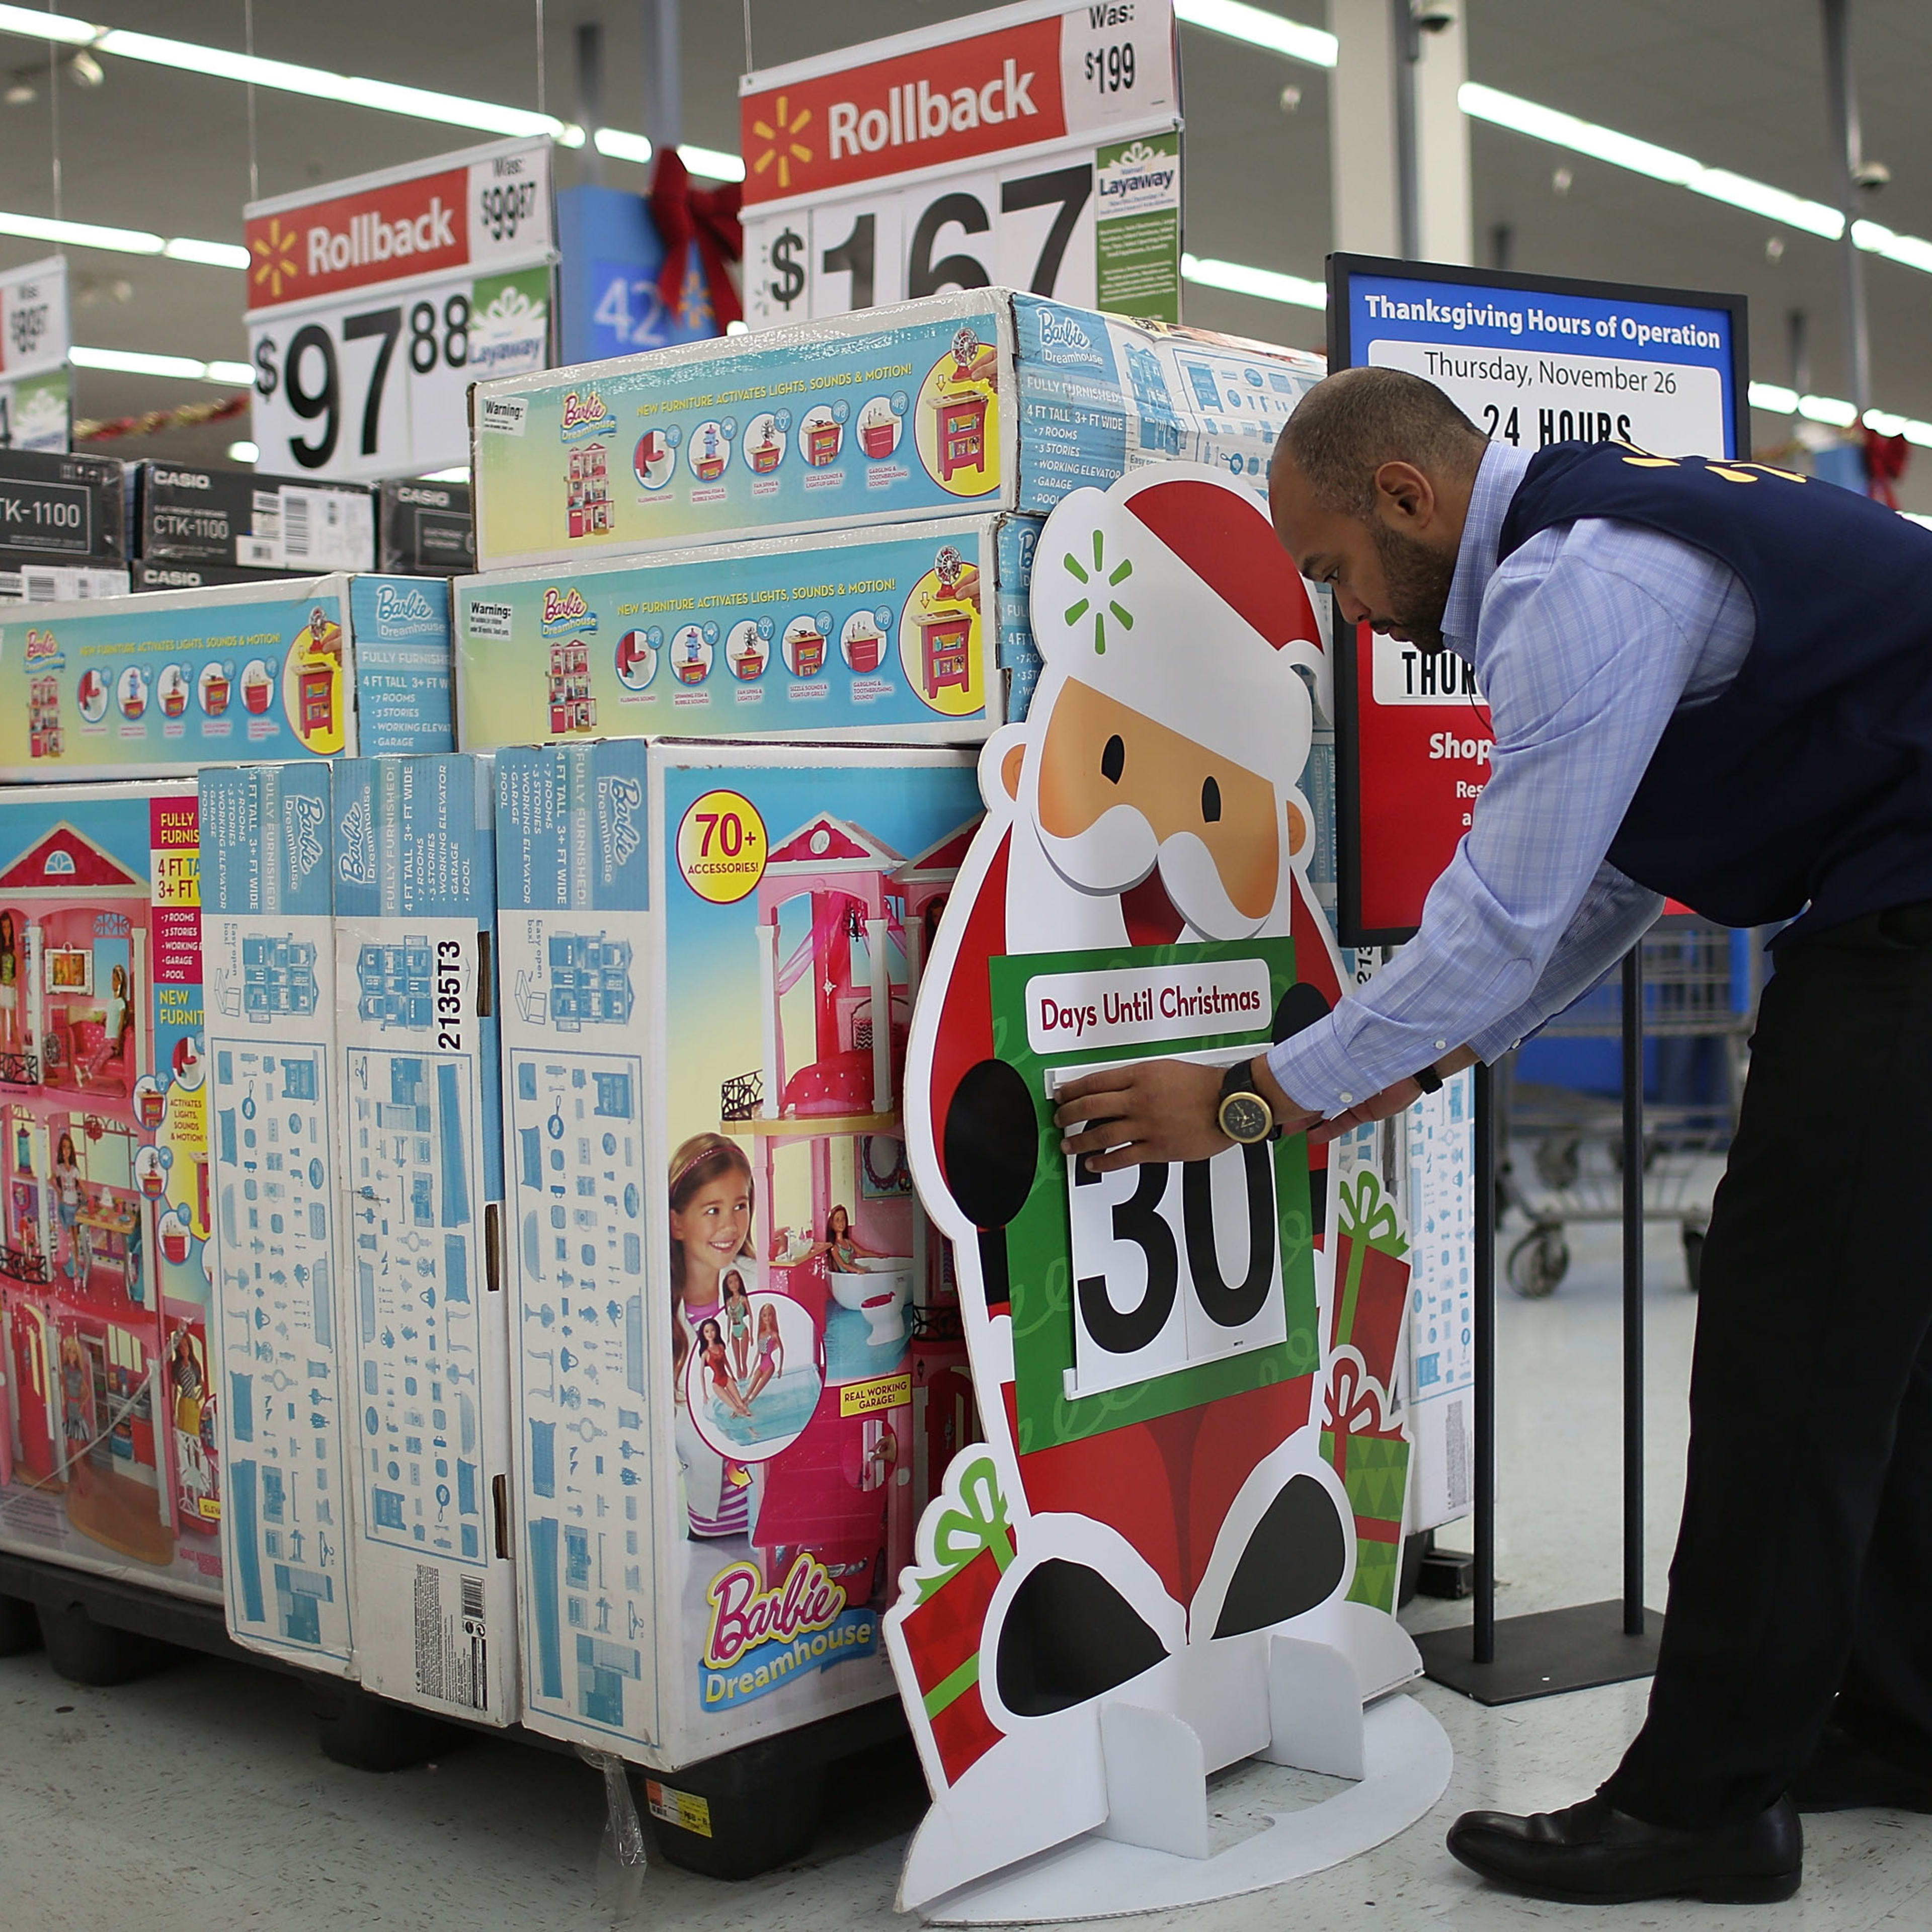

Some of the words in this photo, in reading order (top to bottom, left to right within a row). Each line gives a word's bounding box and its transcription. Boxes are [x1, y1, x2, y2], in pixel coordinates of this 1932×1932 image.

[1090, 4, 1134, 29] Was:
[1085, 42, 1135, 94] $199
[829, 59, 1038, 160] Rollback
[1100, 170, 1174, 197] Layaway
[307, 197, 455, 276] Rollback
[594, 277, 666, 345] 42
[1365, 295, 1522, 334] Thanksgiving
[1528, 308, 1591, 336] Hours
[1595, 315, 1617, 338] of
[1622, 317, 1720, 349] Operation
[1038, 309, 1089, 348] Barbie
[469, 337, 540, 365] Layaway
[1044, 349, 1103, 366] Dreamhouse
[1424, 351, 1532, 387] Thursday,
[1540, 361, 1647, 391] November
[1654, 371, 1676, 394] 26
[636, 403, 659, 417] NEW
[661, 395, 712, 413] FURNITURE
[716, 387, 766, 404] ACTIVATES
[769, 381, 807, 396] LIGHTS,
[810, 374, 851, 390] SOUNDS
[854, 372, 862, 383] &
[865, 363, 912, 381] MOTION!
[1028, 376, 1059, 392] FULLY
[1063, 383, 1121, 403] FURNISHED!
[486, 401, 523, 420] Warning:
[564, 394, 606, 427] Barbie
[1027, 405, 1033, 416] 4
[1035, 406, 1046, 418] FT
[1049, 407, 1070, 422] TALL
[1089, 414, 1099, 426] FT
[1102, 416, 1123, 430] WIDE
[562, 420, 615, 440] Dreamhouse
[1045, 427, 1077, 440] ROOMS
[1483, 405, 1520, 446] 24
[1540, 409, 1631, 446] HOURS
[1046, 443, 1080, 457] STORIES
[1130, 454, 1145, 466] Easy
[154, 470, 210, 490] CASIO
[1039, 459, 1079, 473] WORKING
[1081, 465, 1121, 479] ELEVATOR
[1038, 476, 1072, 490] GARAGE
[398, 488, 449, 506] CASIO
[154, 515, 229, 540] CTK-1100
[144, 569, 201, 587] CASIO
[377, 584, 432, 620] Barbie
[542, 589, 586, 622] Barbie
[618, 604, 639, 616] NEW
[642, 598, 694, 613] FURNITURE
[698, 593, 748, 608] ACTIVATES
[751, 589, 789, 603] LIGHTS,
[793, 584, 834, 599] SOUNDS
[838, 584, 845, 595] &
[848, 579, 896, 594] MOTION!
[471, 602, 511, 619] Warning:
[381, 621, 446, 637] Dreamhouse
[543, 617, 596, 635] Dreamhouse
[1016, 633, 1026, 645] FT
[362, 652, 395, 663] FULLY
[363, 676, 369, 687] 4
[371, 676, 382, 687] FT
[385, 677, 407, 688] TALL
[427, 678, 437, 689] FT
[383, 694, 416, 703] ROOMS
[383, 708, 419, 717] STORIES
[378, 722, 420, 732] WORKING
[378, 737, 414, 747] GARAGE
[1429, 732, 1493, 765] Shop
[556, 753, 565, 761] 4
[404, 766, 412, 800] WIDE
[556, 765, 566, 781] FT
[576, 753, 585, 803] FULLY
[511, 772, 519, 825] GARAGE
[522, 772, 530, 835] WORKING
[557, 785, 566, 818] TALL
[160, 813, 194, 827] FULLY
[404, 804, 412, 819] FT
[612, 778, 640, 865] Barbie
[298, 796, 324, 874] Barbie
[340, 802, 363, 883] Barbie
[365, 785, 375, 879] Dreamhouse
[598, 782, 611, 882] Dreamhouse
[695, 813, 756, 857] 70+
[285, 800, 298, 891] Dreamhouse
[557, 849, 567, 864] FT
[576, 808, 586, 905] FURNISHED!
[158, 859, 165, 876] 4
[169, 858, 183, 876] FT
[404, 849, 413, 879] TALL
[523, 838, 531, 904] ELEVATOR
[688, 862, 758, 874] ACCESSORIES!
[158, 880, 174, 898] 3+
[179, 880, 193, 898] FT
[405, 884, 413, 899] FT
[557, 869, 567, 904] WIDE
[169, 913, 195, 922] ROOMS
[170, 927, 197, 936] STORIES
[165, 941, 198, 950] WORKING
[165, 956, 193, 965] GARAGE
[166, 970, 185, 979] POOL
[159, 990, 189, 1005] NEW
[437, 940, 461, 1050] 2135T3
[1041, 998, 1097, 1037] Days
[1104, 991, 1154, 1024] Until
[1159, 987, 1260, 1019] Christmas
[170, 1099, 202, 1108] ACTIVATES
[174, 1121, 199, 1130] SOUNDS
[177, 1133, 203, 1142] MOTION!
[1074, 1116, 1275, 1354] 30
[845, 1391, 865, 1402] REAL
[867, 1382, 907, 1396] WORKING
[859, 1394, 895, 1409] GARAGE!
[711, 1559, 841, 1661] Barbie
[706, 1622, 871, 1703] Dreamhouse
